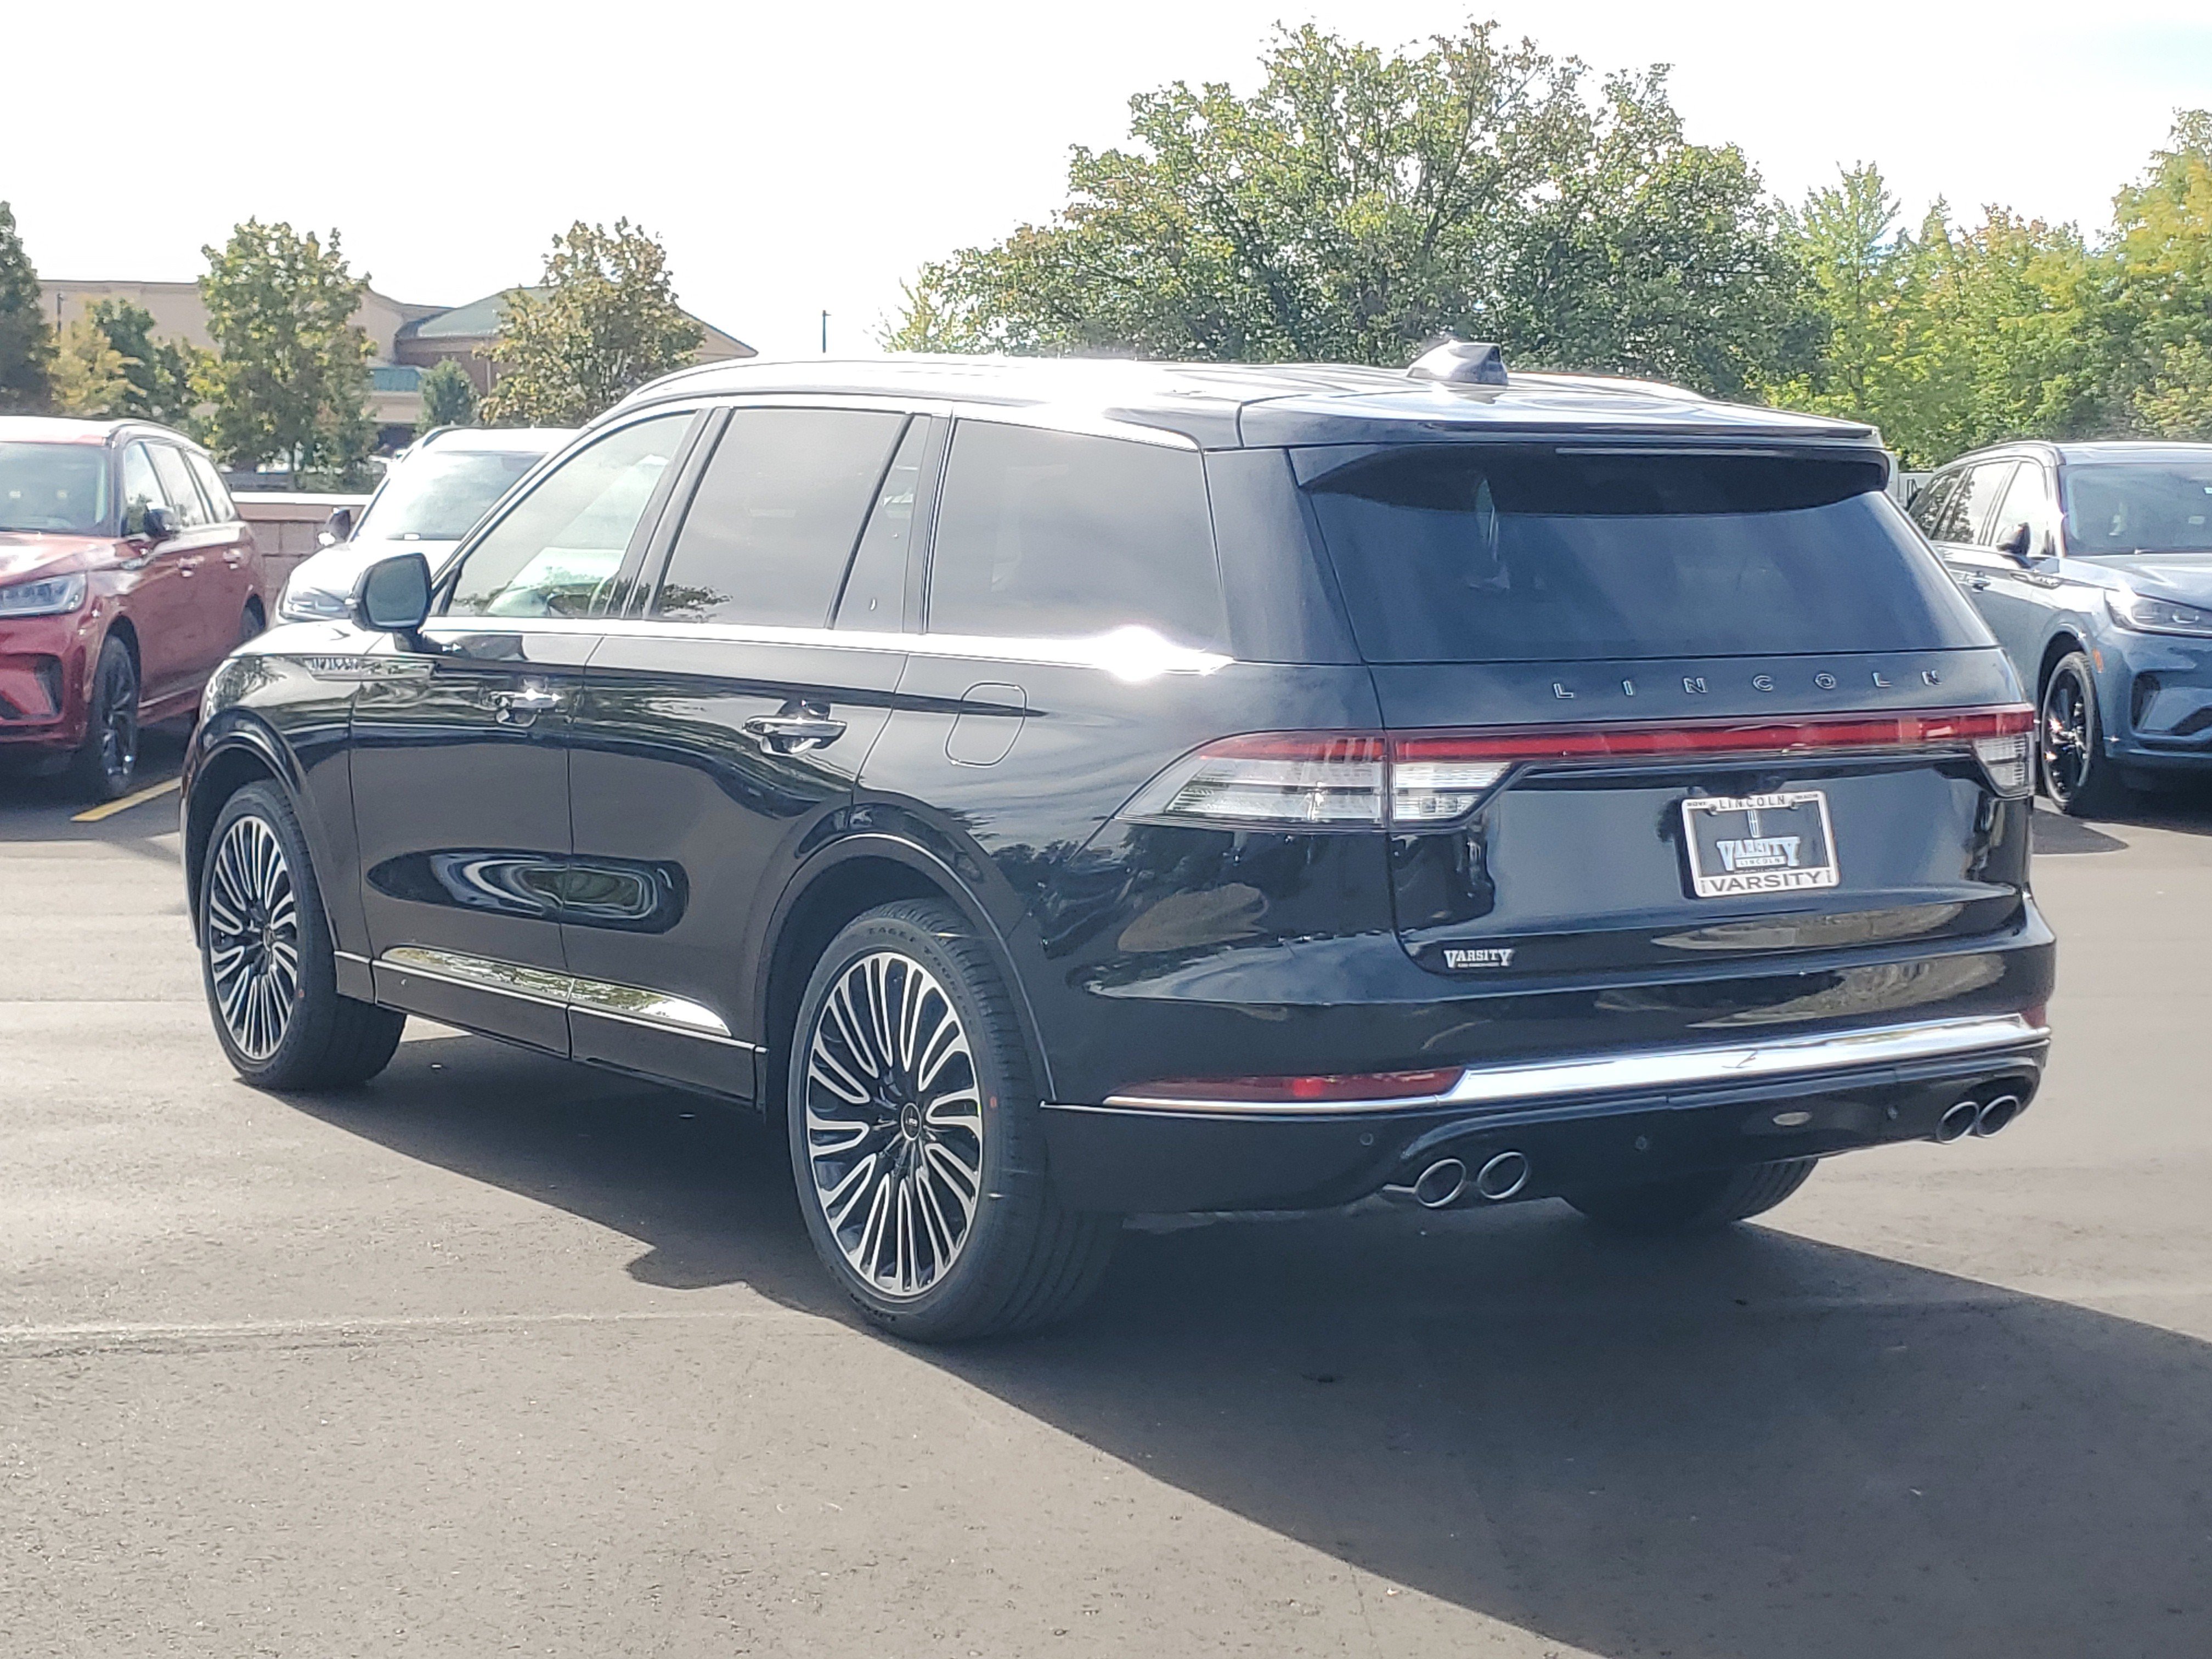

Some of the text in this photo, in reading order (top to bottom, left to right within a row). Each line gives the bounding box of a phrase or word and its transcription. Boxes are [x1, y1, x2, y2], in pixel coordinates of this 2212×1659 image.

[1553, 670, 1943, 699] LINCOLN
[1719, 795, 1785, 809] LINCOLN
[1716, 836, 1800, 871] VARSITY
[1710, 872, 1821, 892] VARSITY
[1444, 949, 1513, 968] VARSITY
